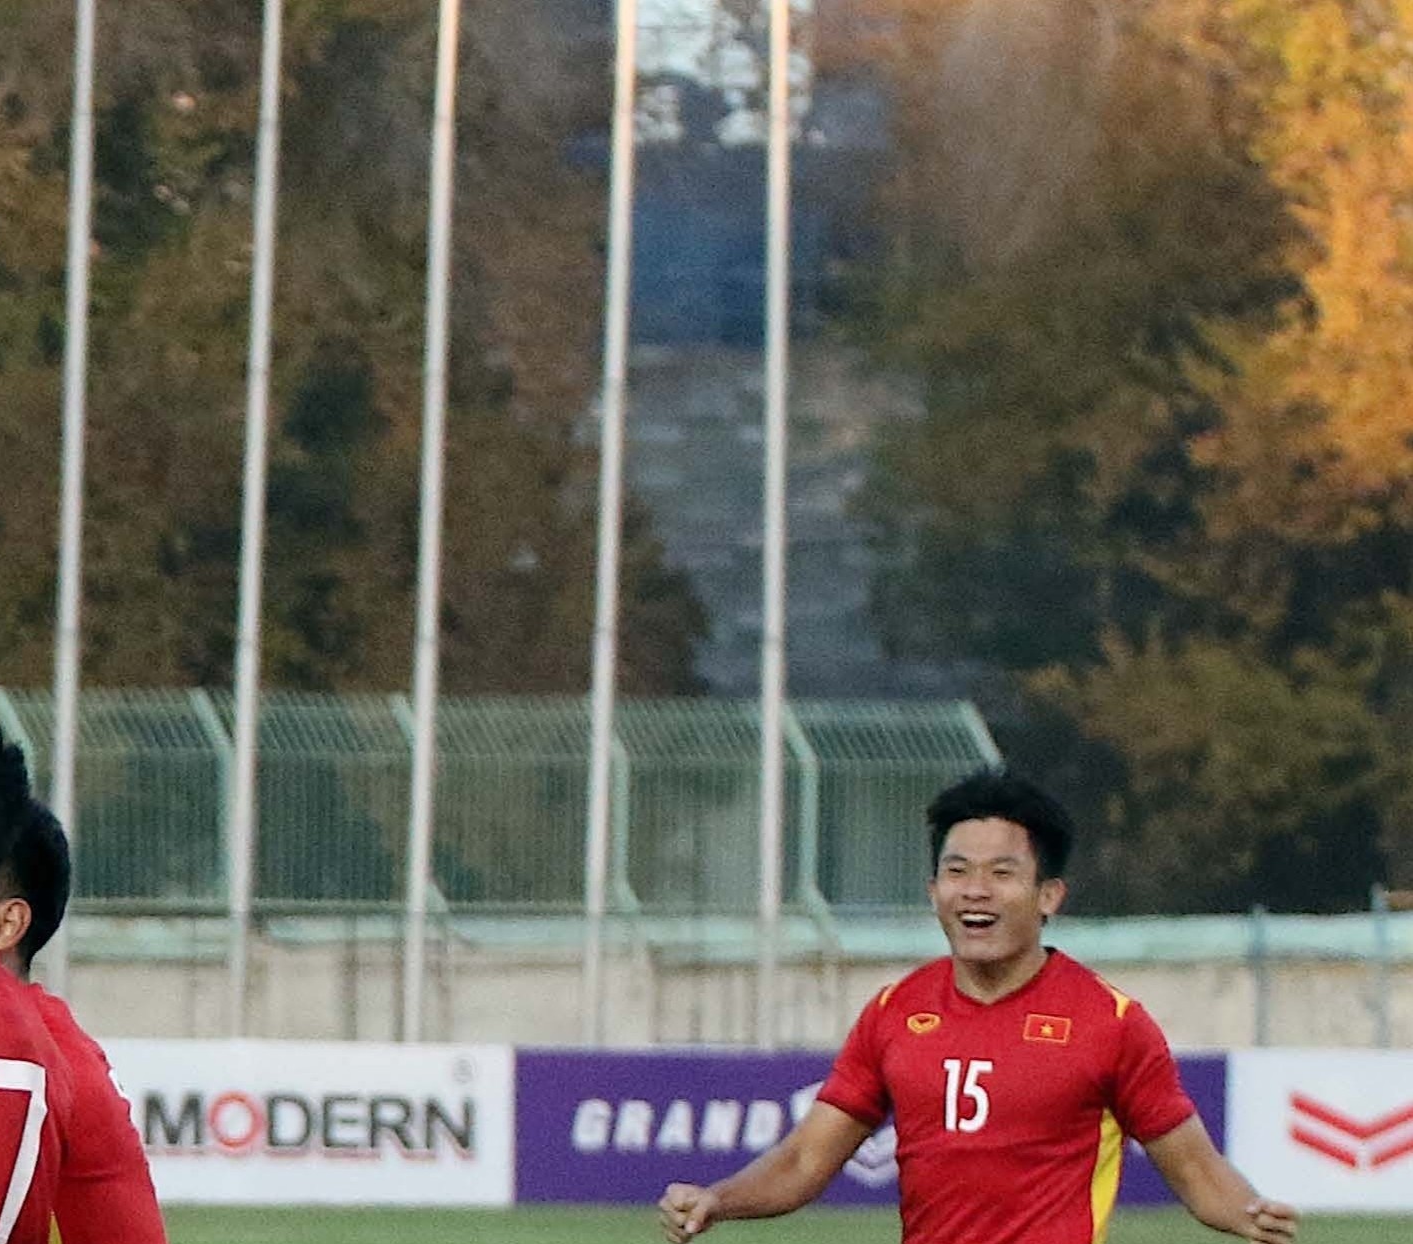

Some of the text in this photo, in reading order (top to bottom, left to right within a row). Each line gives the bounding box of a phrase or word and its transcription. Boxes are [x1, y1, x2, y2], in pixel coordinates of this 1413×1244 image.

[143, 1089, 476, 1154] MODERN
[572, 1097, 784, 1152] GRAND
[943, 1058, 994, 1133] 15
